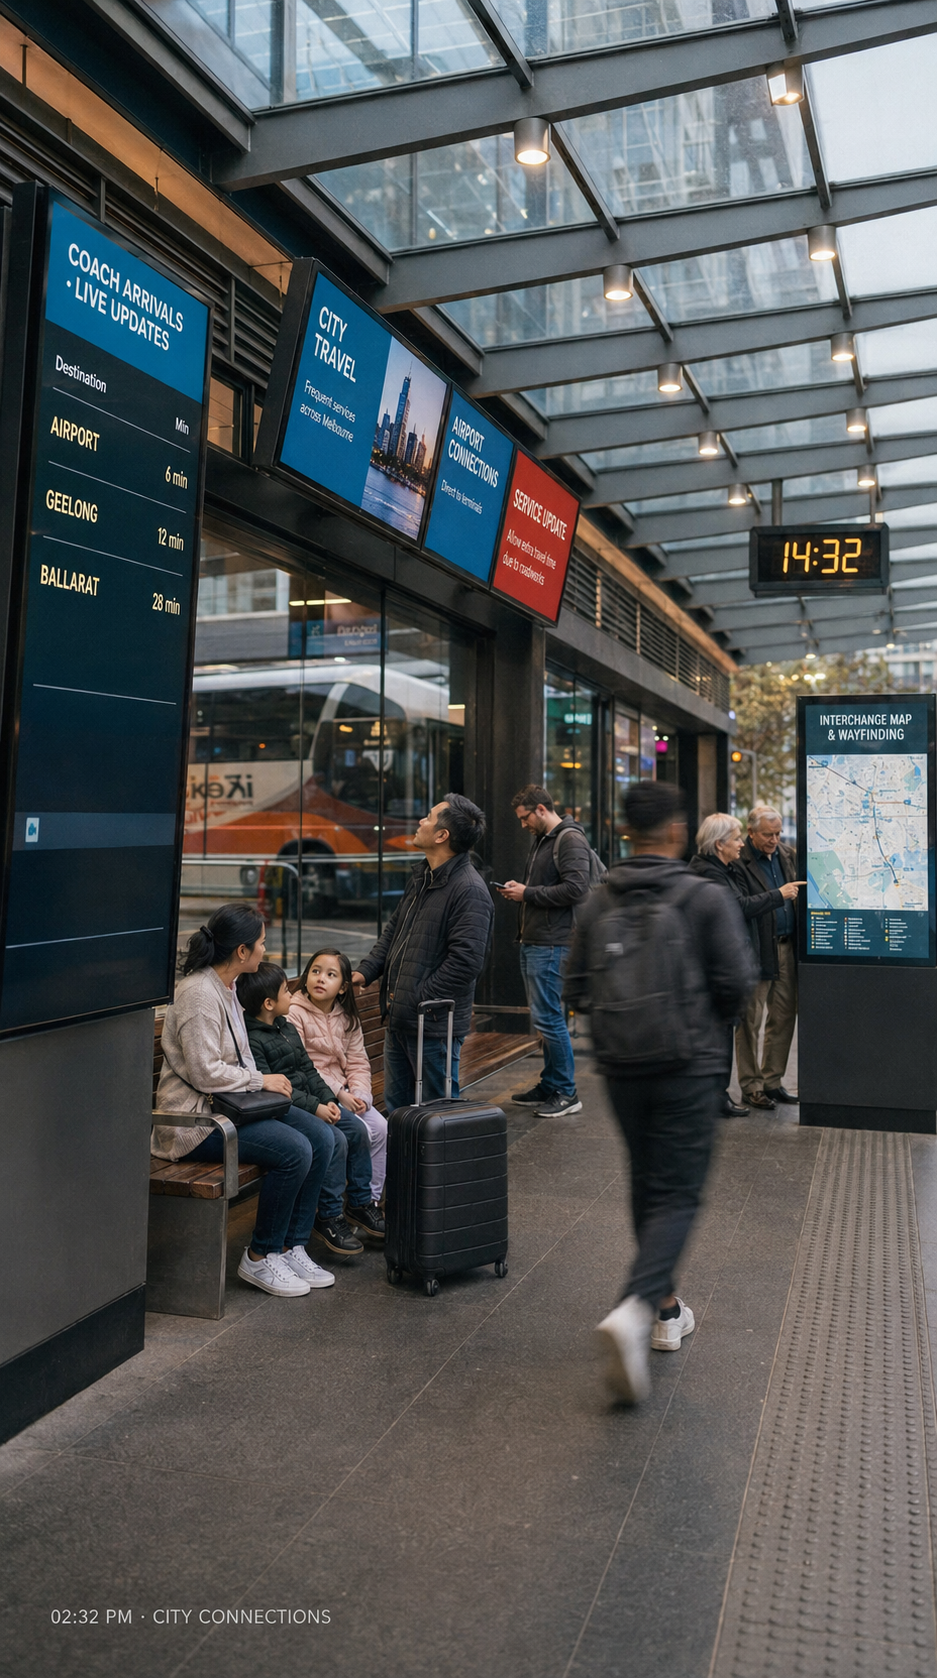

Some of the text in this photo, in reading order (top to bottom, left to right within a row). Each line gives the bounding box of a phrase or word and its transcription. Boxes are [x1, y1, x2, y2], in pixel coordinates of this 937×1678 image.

[68, 243, 184, 333] COACH ARRIVALS
[75, 276, 170, 351] LIVE UPDATES
[319, 306, 348, 343] CITY
[55, 354, 107, 393] Destination
[314, 332, 356, 383] TRAVEL
[300, 403, 321, 424] across
[304, 379, 356, 423] Frequent services
[50, 416, 100, 451] AIRPORT
[175, 417, 189, 435] Min
[451, 416, 485, 453] AIRPORT
[165, 465, 188, 489] 6 min
[448, 439, 499, 488] CONNECTIONS
[46, 489, 98, 523] GEELONG
[513, 488, 567, 541] SERVICE UPDATE
[157, 527, 184, 551] 12 min
[506, 528, 521, 548] Allow
[502, 550, 513, 568] due
[782, 538, 862, 574] 14:32
[40, 564, 100, 597] BALLARAT
[152, 592, 180, 615] 28 min
[820, 713, 912, 726] INTERCHANGE MAP
[827, 728, 905, 741] & WAYFINDING
